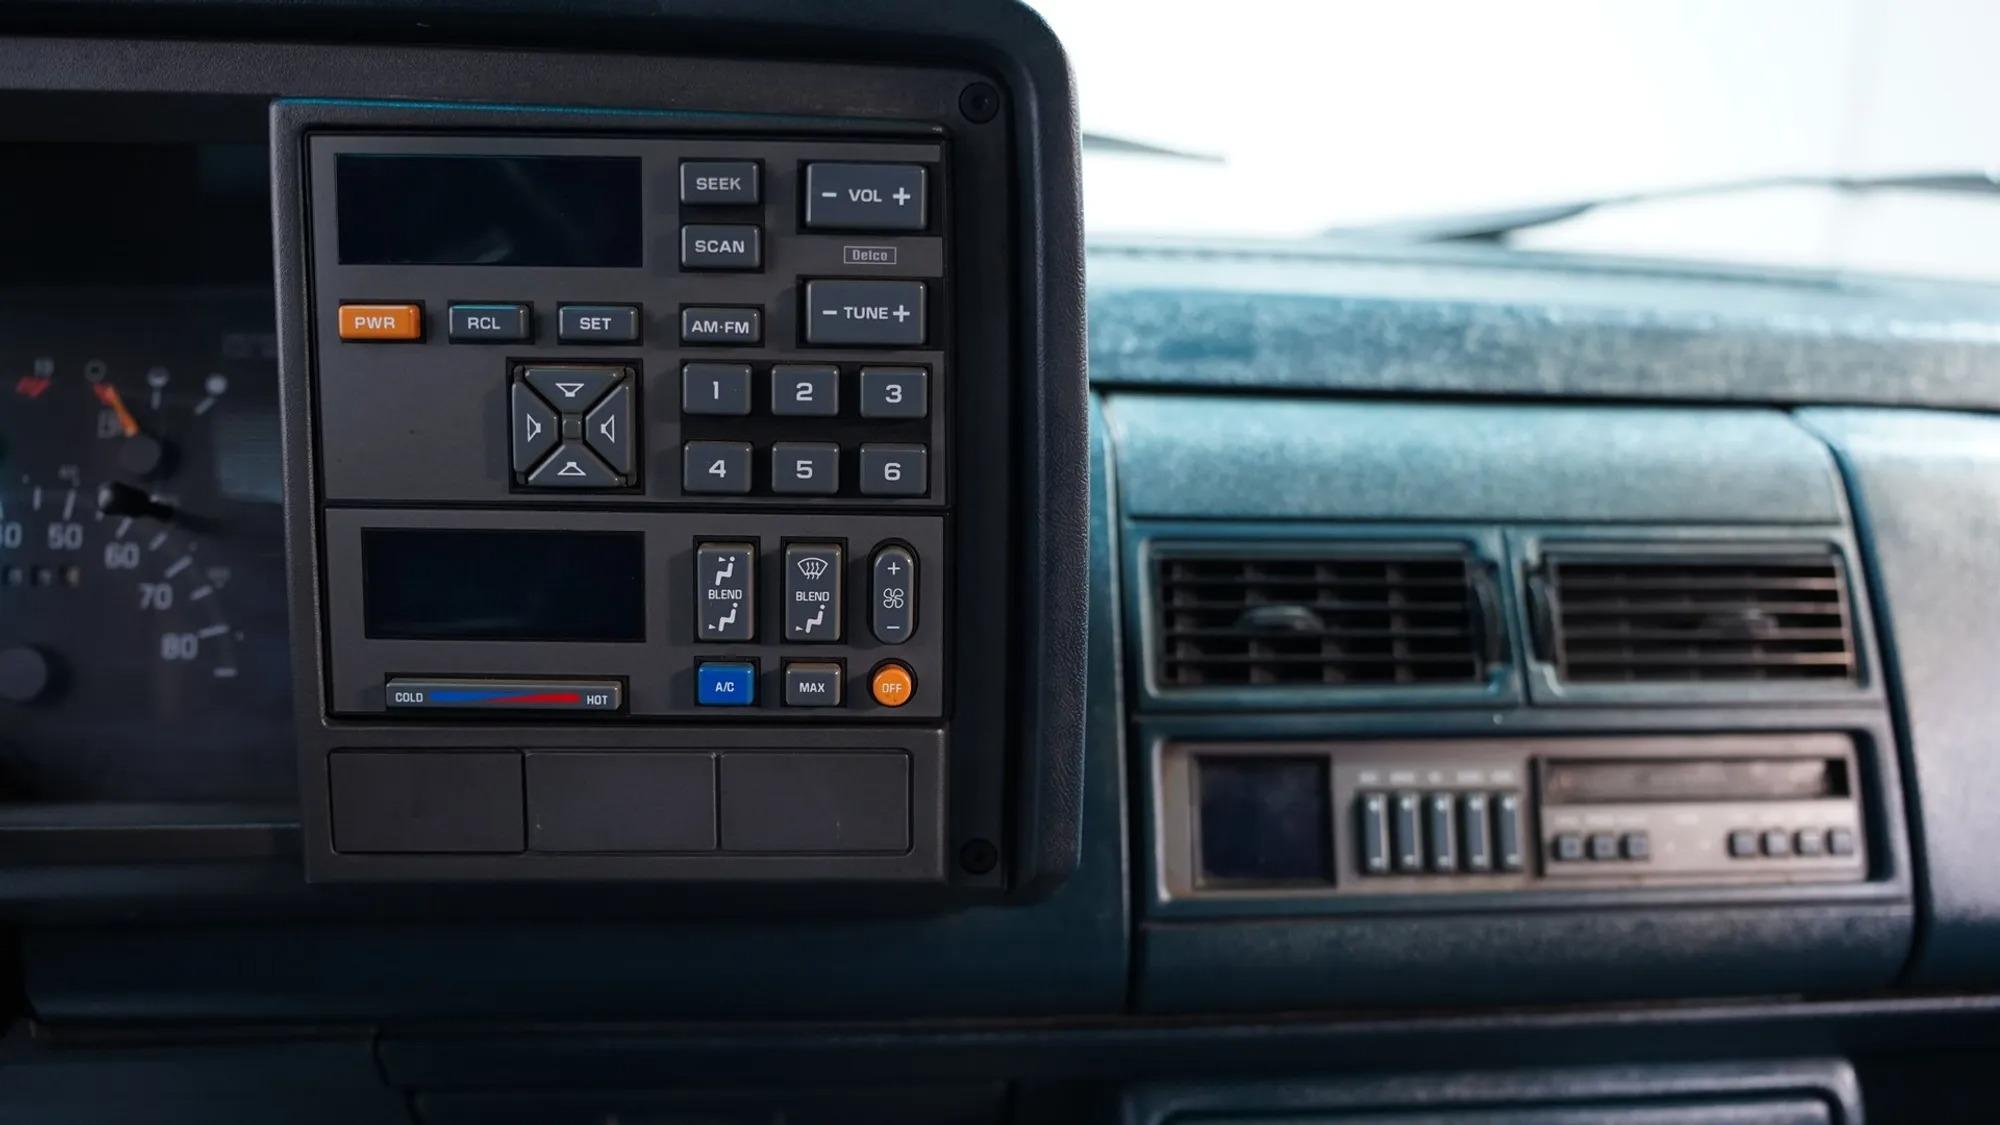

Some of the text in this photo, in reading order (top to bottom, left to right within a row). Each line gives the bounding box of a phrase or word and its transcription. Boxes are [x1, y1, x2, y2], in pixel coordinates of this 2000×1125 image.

[696, 177, 742, 191] SEEK
[848, 188, 883, 203] VOL
[695, 239, 745, 254] SCAN
[852, 249, 888, 261] Delco
[843, 306, 889, 320] TUNE
[354, 316, 396, 330] PWR
[467, 316, 501, 330] RCL
[579, 317, 612, 330] SET
[712, 380, 719, 400] 1
[796, 382, 813, 401] 2
[885, 384, 903, 404] 3
[708, 459, 727, 478] 4
[796, 460, 813, 479] 5
[884, 462, 901, 481] 6
[0, 522, 22, 548] 0
[47, 523, 83, 550] 50
[104, 542, 140, 569] 60
[140, 583, 173, 611] 70
[708, 588, 743, 600] BLEND
[795, 590, 830, 602] BLEND
[161, 634, 199, 660] 80
[715, 681, 735, 693] A/C
[799, 682, 825, 693] MAX
[881, 683, 903, 695] OFF
[395, 692, 424, 703] COLD
[586, 694, 608, 706] HOT
